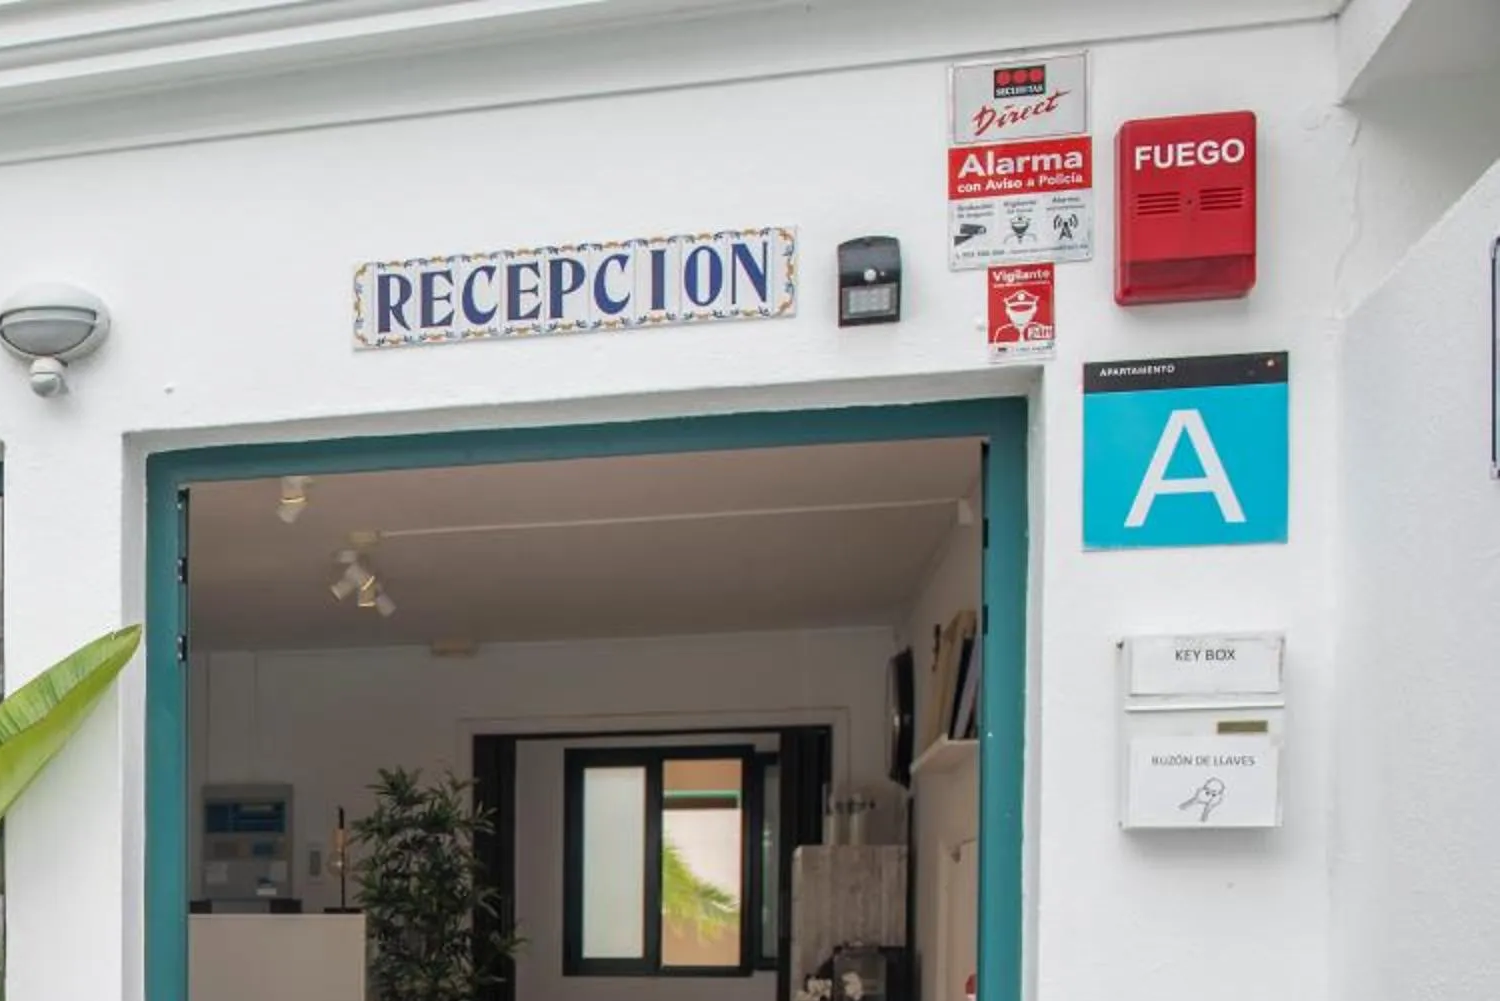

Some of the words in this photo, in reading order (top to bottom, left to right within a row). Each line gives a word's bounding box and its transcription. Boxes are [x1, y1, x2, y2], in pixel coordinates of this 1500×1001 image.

[972, 89, 1071, 136] Direct
[957, 150, 1083, 179] Alarma
[1134, 138, 1245, 171] FUEGO
[957, 182, 981, 193] con
[986, 178, 1022, 191] Aviso
[1026, 179, 1035, 187] a
[377, 241, 769, 333] RECEPCION
[992, 270, 1050, 283] Vigilante
[1099, 364, 1176, 377] APARTAMENTO
[1123, 408, 1247, 528] A
[1175, 649, 1201, 662] KEY
[1205, 649, 1237, 662] BOX
[1151, 754, 1193, 767] BUZÓN
[1195, 755, 1209, 767] DE
[1213, 754, 1256, 767] LLAVES
